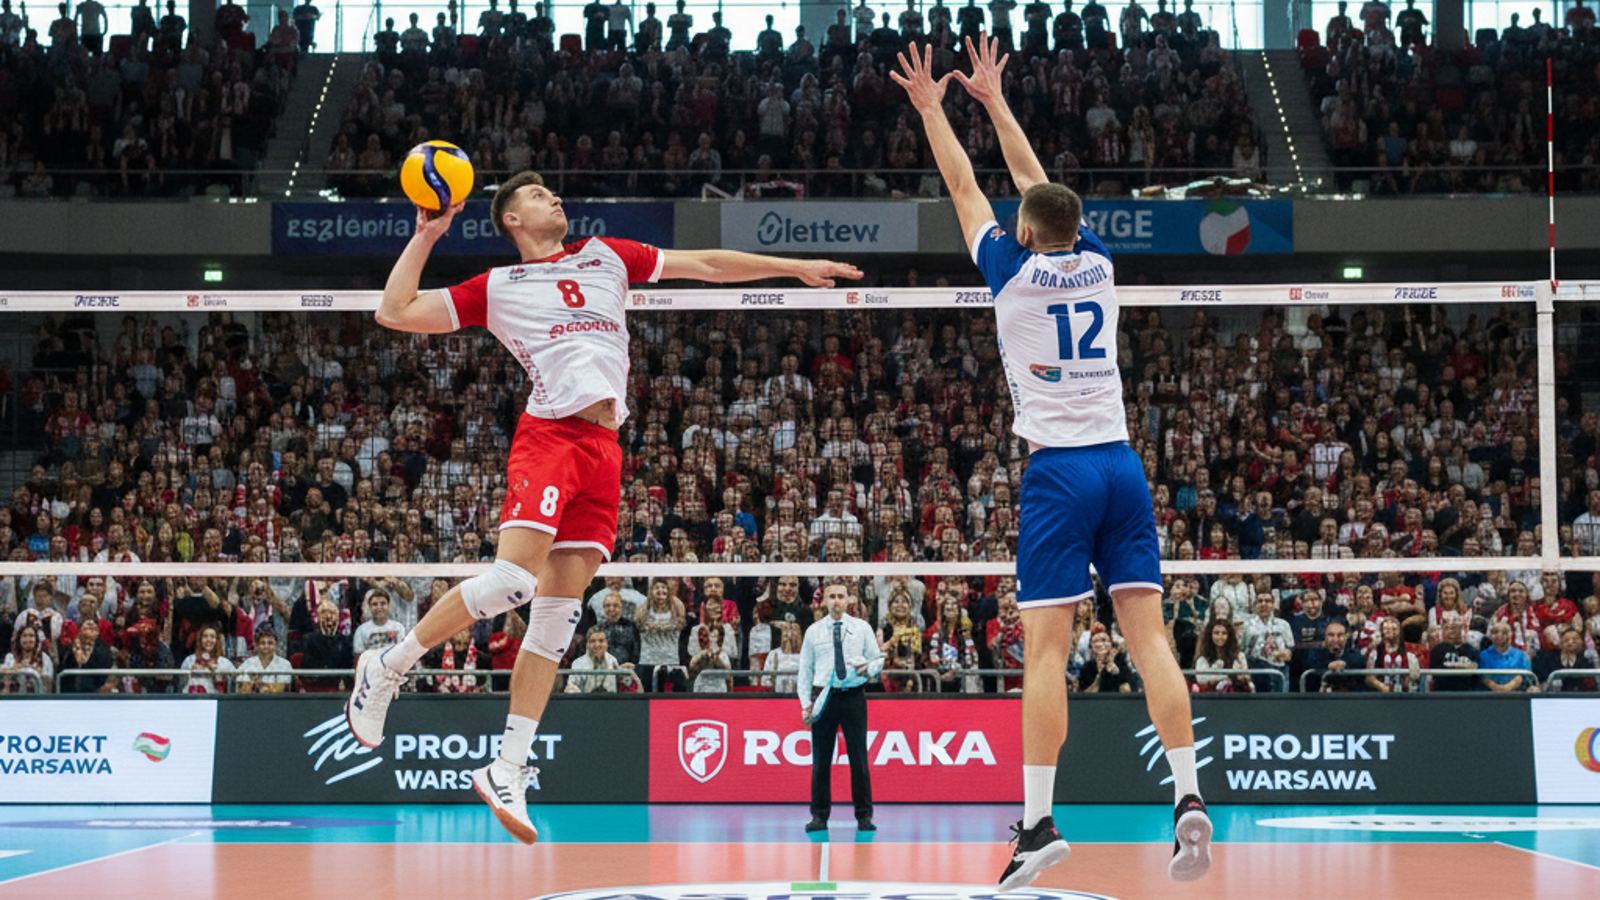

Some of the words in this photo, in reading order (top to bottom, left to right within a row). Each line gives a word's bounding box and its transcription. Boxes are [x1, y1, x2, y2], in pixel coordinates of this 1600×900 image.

[556, 279, 586, 309] 8
[1047, 301, 1106, 360] 12
[540, 485, 560, 517] 8
[743, 730, 997, 766] ROAKA
[1224, 734, 1395, 760] PROJEKT
[395, 769, 541, 790] WARSA
[1226, 769, 1377, 791] WARSAWA
